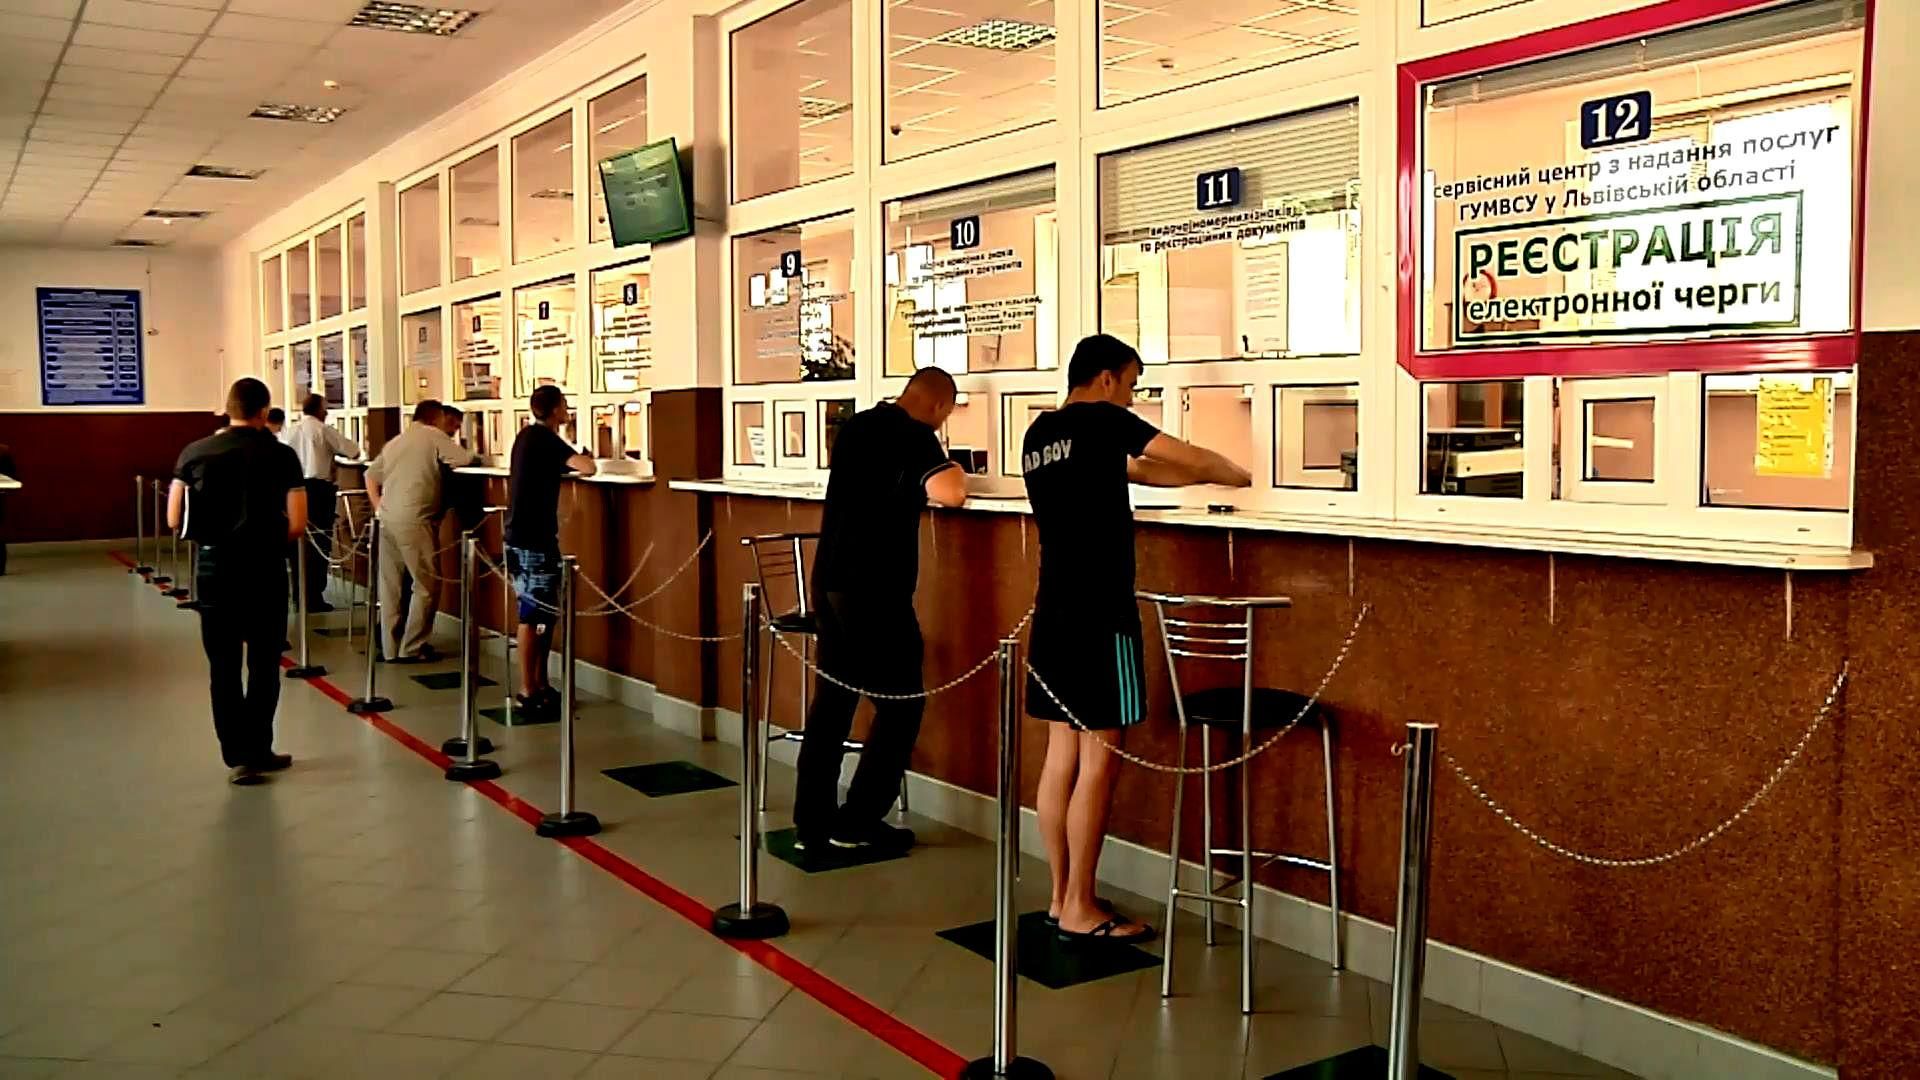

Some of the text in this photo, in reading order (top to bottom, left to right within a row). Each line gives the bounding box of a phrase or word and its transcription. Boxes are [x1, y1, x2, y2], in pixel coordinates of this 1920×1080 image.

[1591, 98, 1640, 145] 12
[1434, 126, 1840, 198] сервісний центр з надання послуг
[1203, 172, 1233, 207] 11
[1459, 160, 1796, 221] ГУМВСУ у Львівській області
[954, 220, 975, 248] 10
[1236, 218, 1306, 240] документів
[1469, 213, 1782, 279] РЕЄСТРАЦІЯ
[786, 254, 796, 276] 9
[1469, 280, 1781, 320] електронної черги
